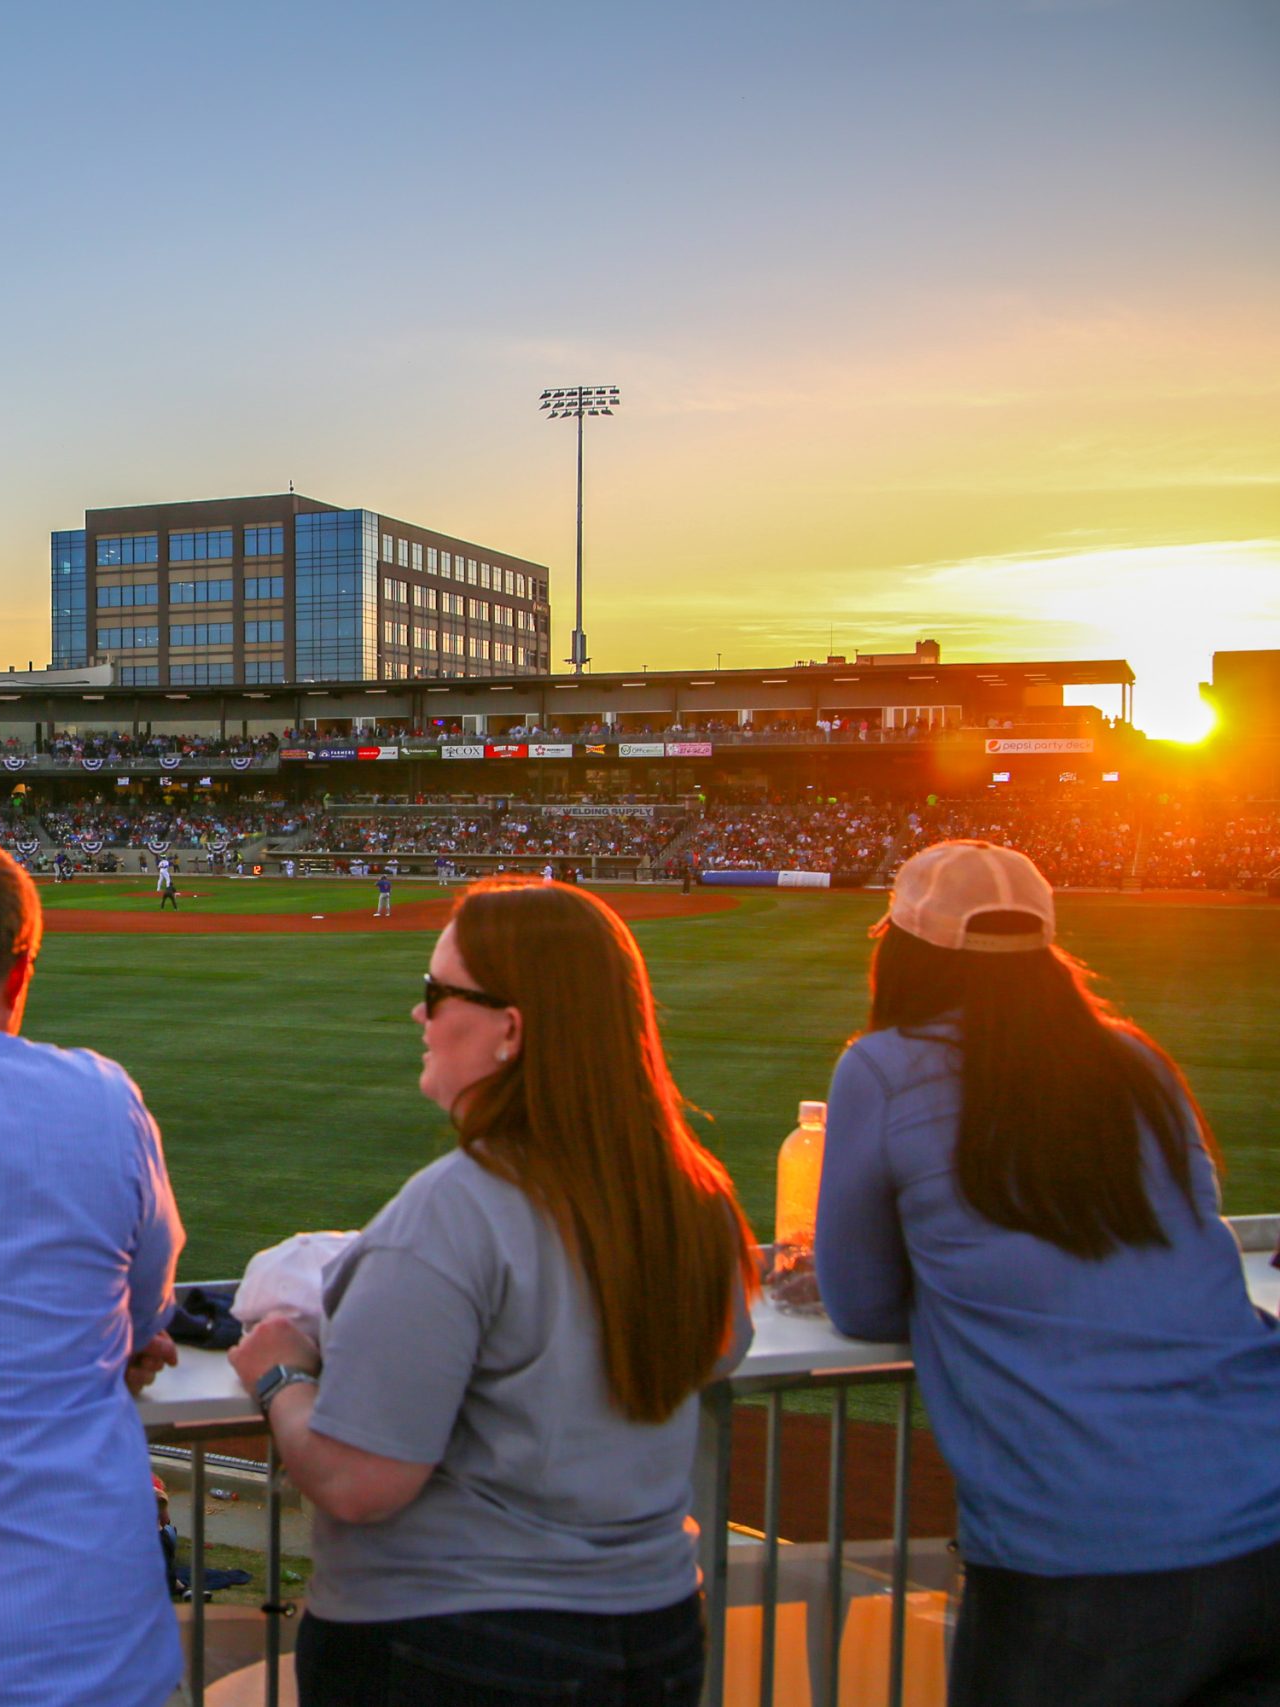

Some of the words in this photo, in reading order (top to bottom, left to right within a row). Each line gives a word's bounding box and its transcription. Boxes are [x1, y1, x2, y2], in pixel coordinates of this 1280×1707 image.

[455, 747, 480, 755] COX
[1003, 742, 1031, 751] pepsi
[1035, 742, 1064, 751] party
[562, 807, 608, 815] WELDING
[611, 807, 651, 816] SUPPLY
